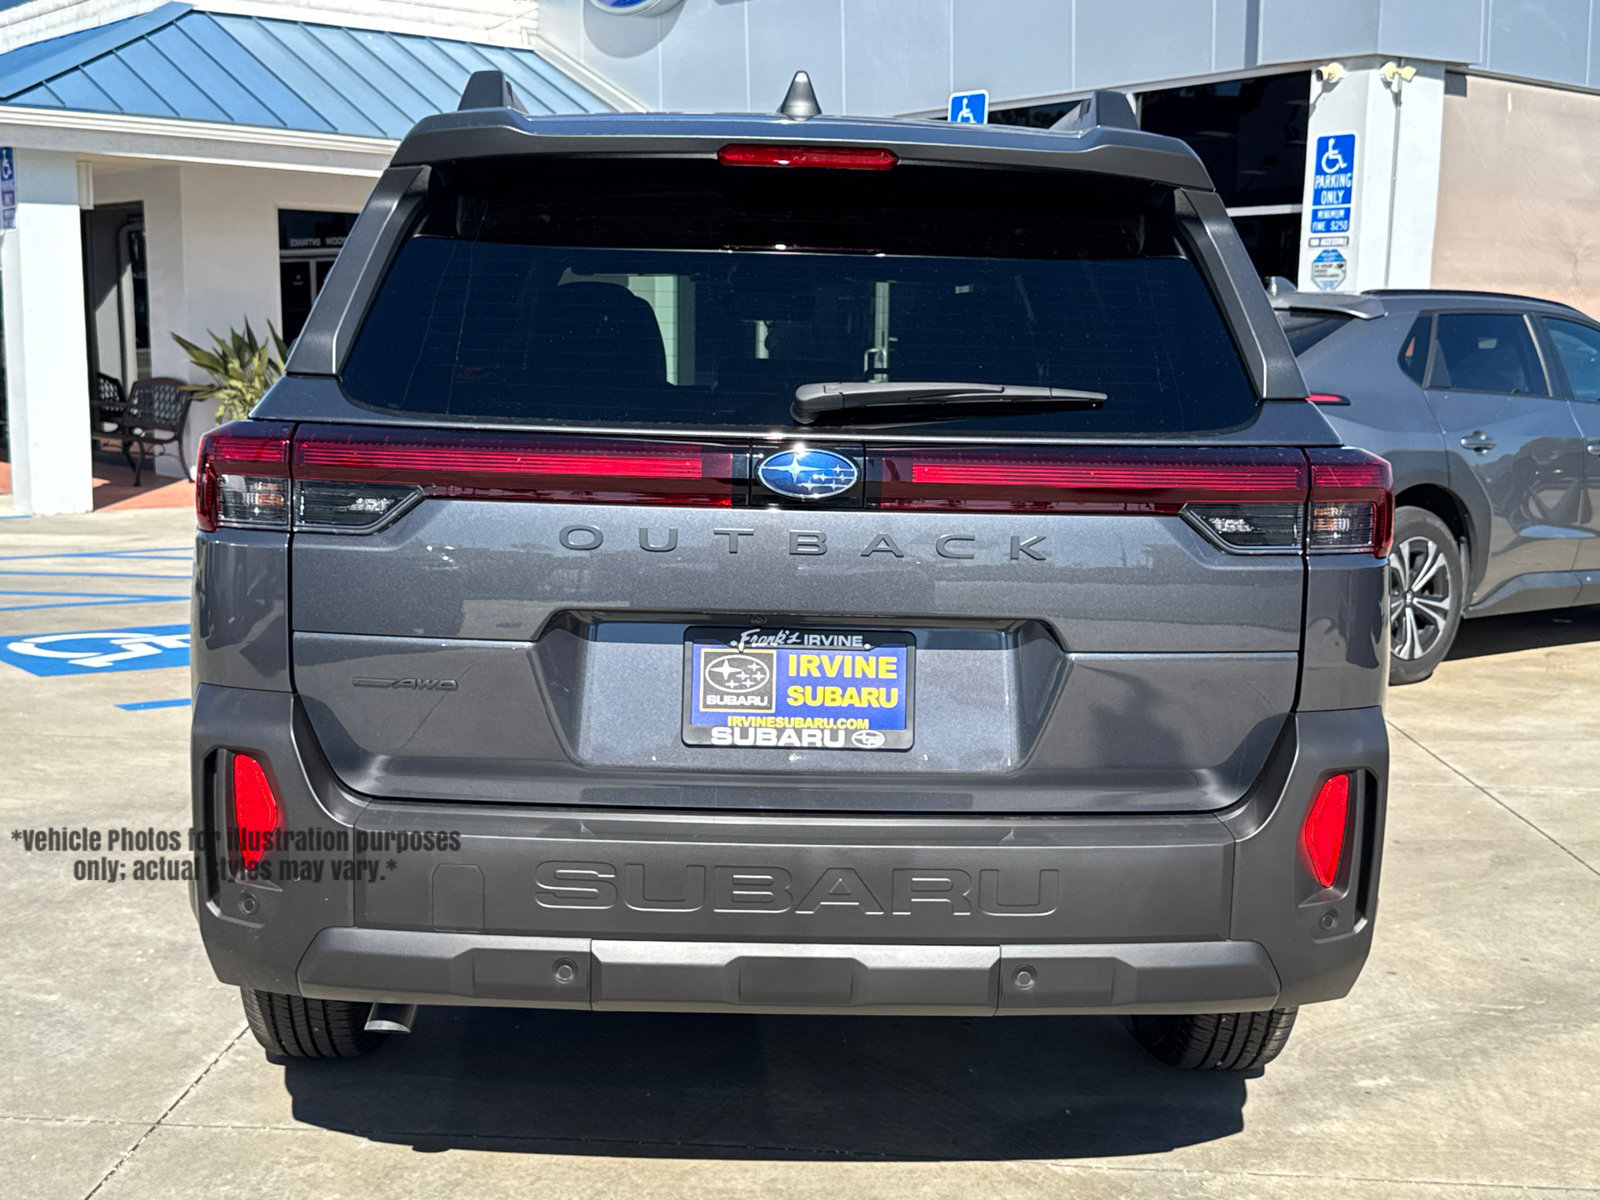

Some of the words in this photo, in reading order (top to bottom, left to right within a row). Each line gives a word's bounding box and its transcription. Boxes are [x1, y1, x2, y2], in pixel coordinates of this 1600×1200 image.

[1315, 173, 1351, 189] PARKING
[1320, 190, 1345, 205] ONLY
[558, 524, 1048, 562] OUTBACK
[804, 634, 863, 647] IRVINE
[788, 654, 898, 679] IRVINE
[706, 694, 769, 707] SUBARU
[787, 686, 898, 708] SUBARU
[727, 714, 870, 730] IRVINESUBARU.COM
[710, 726, 846, 748] SUBARU
[534, 860, 1061, 917] SUBARU
